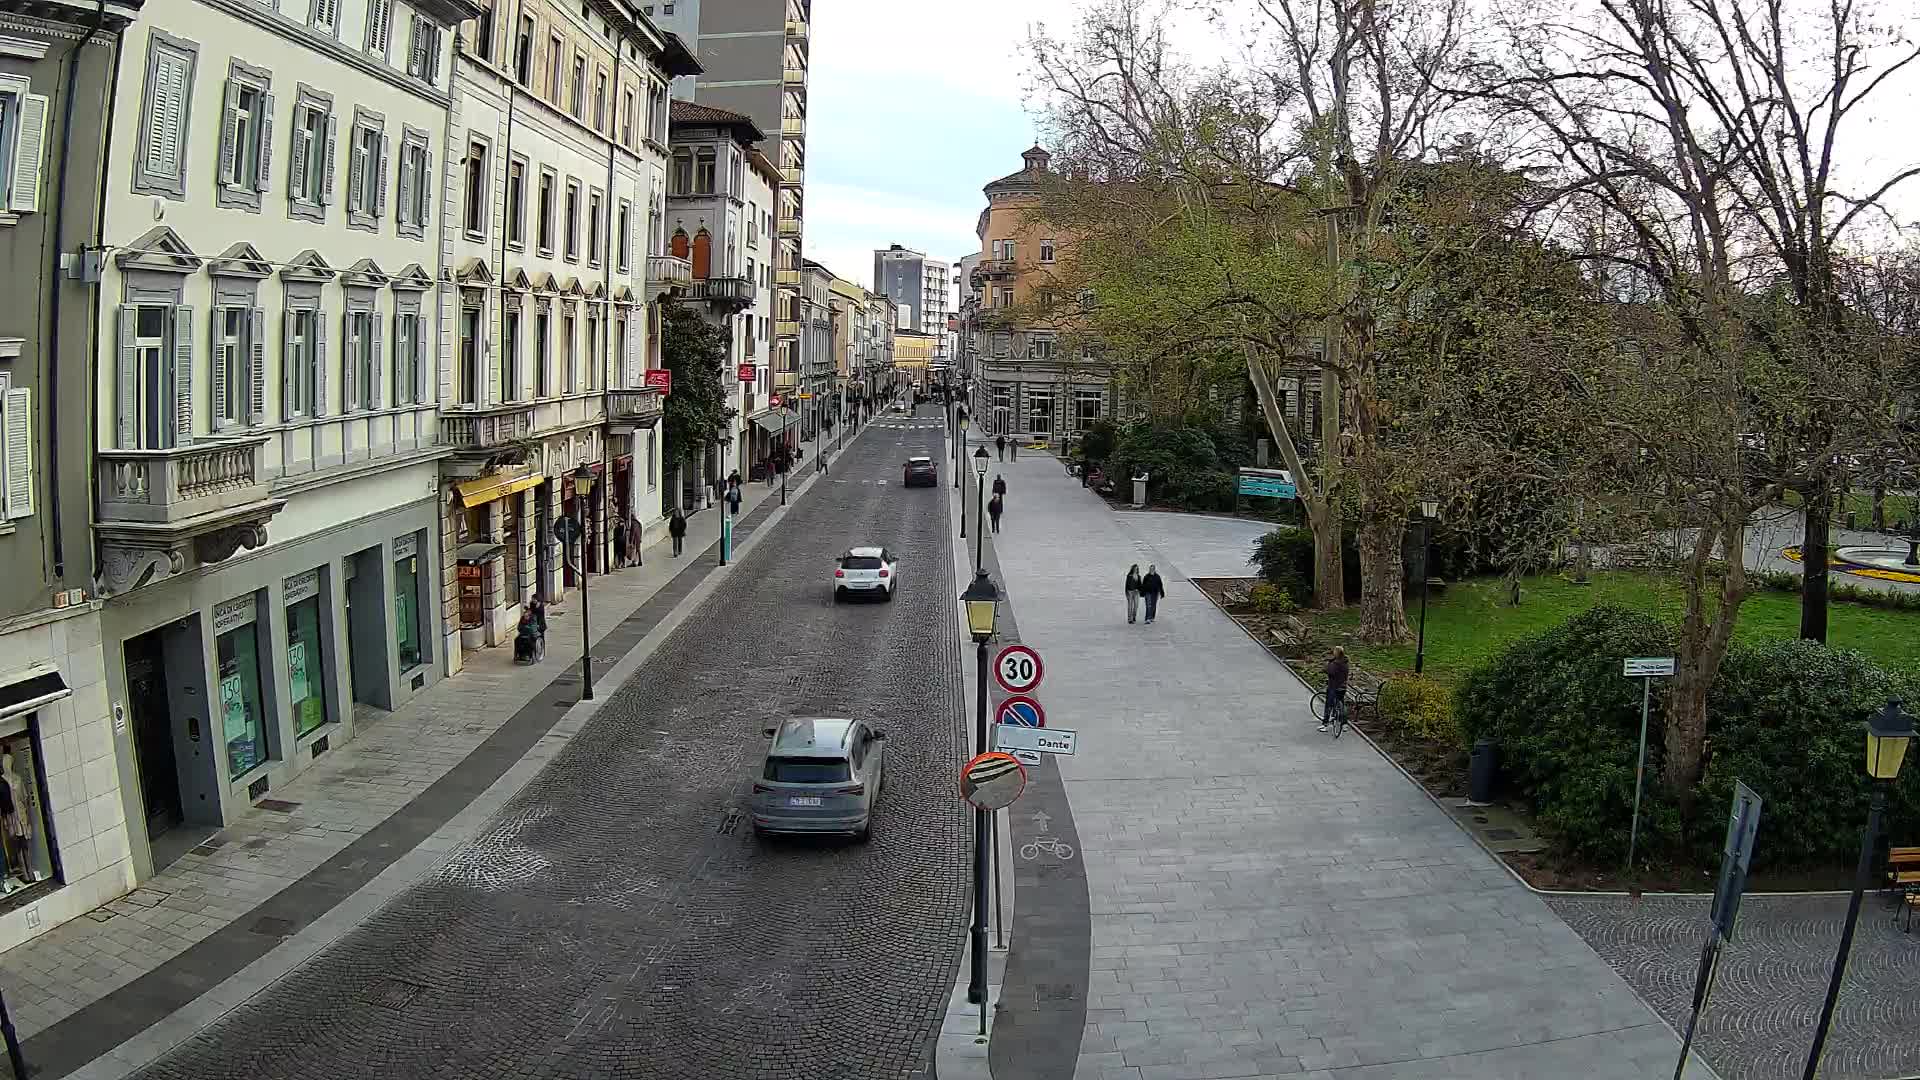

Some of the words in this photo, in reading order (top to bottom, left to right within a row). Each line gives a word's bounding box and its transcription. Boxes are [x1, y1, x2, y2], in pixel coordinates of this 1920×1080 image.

[1005, 658, 1033, 681] 30
[222, 677, 241, 700] 130
[1038, 738, 1070, 750] Dante
